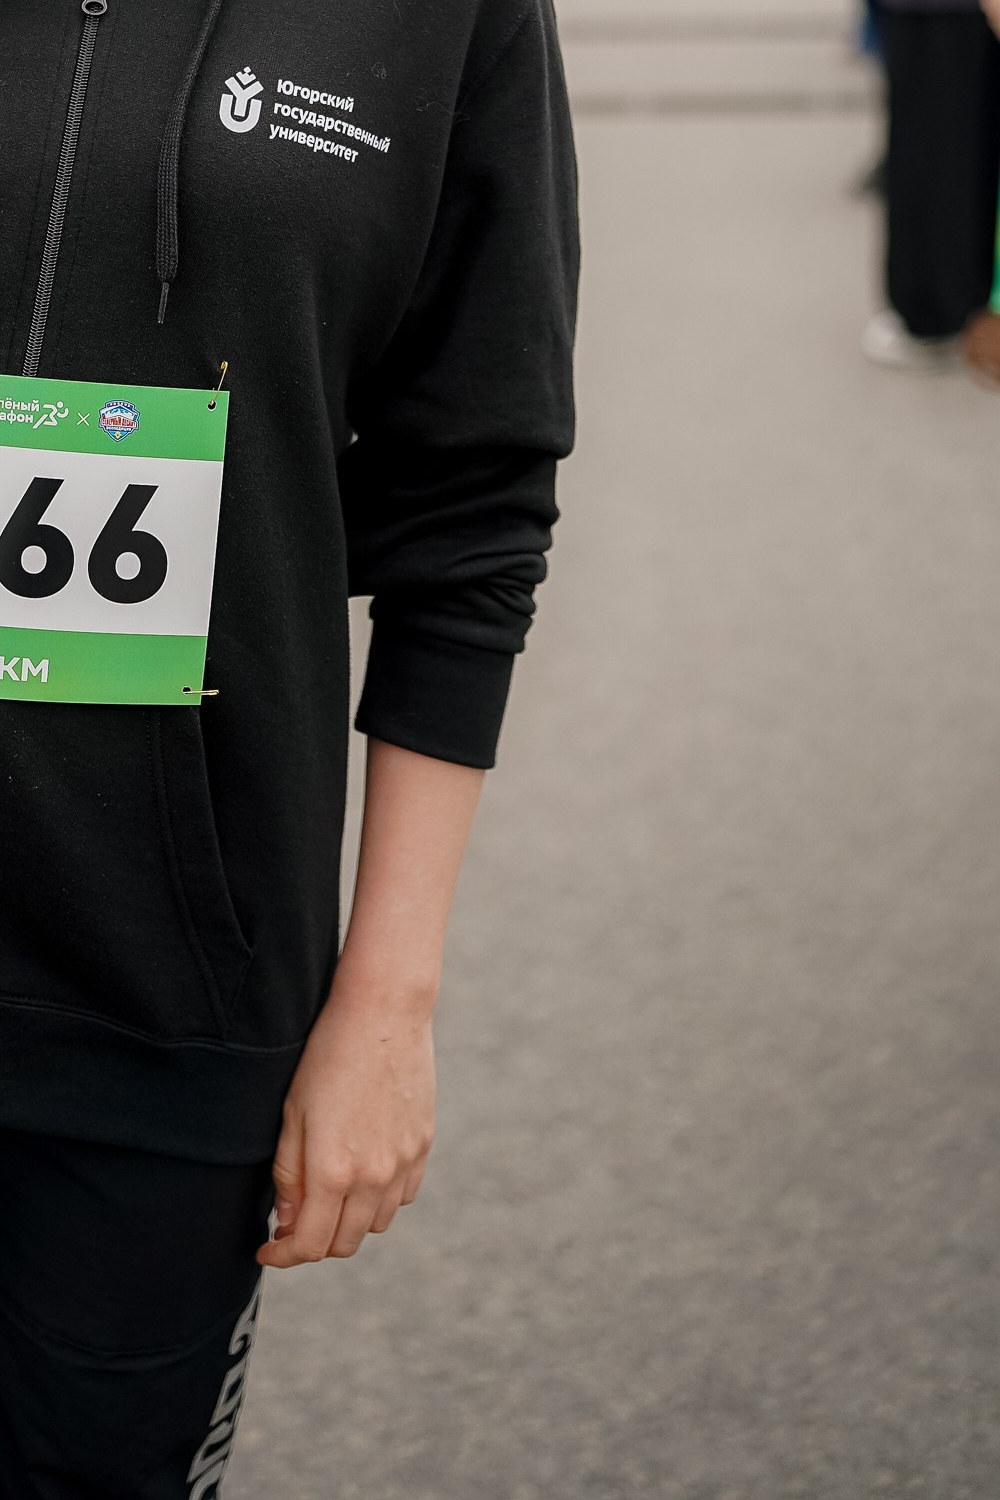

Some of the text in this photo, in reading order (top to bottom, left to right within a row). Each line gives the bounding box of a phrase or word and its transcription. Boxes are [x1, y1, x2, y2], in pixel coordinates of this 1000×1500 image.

[276, 78, 355, 113] Югорский
[269, 123, 360, 163] университет
[273, 102, 391, 154] государственный
